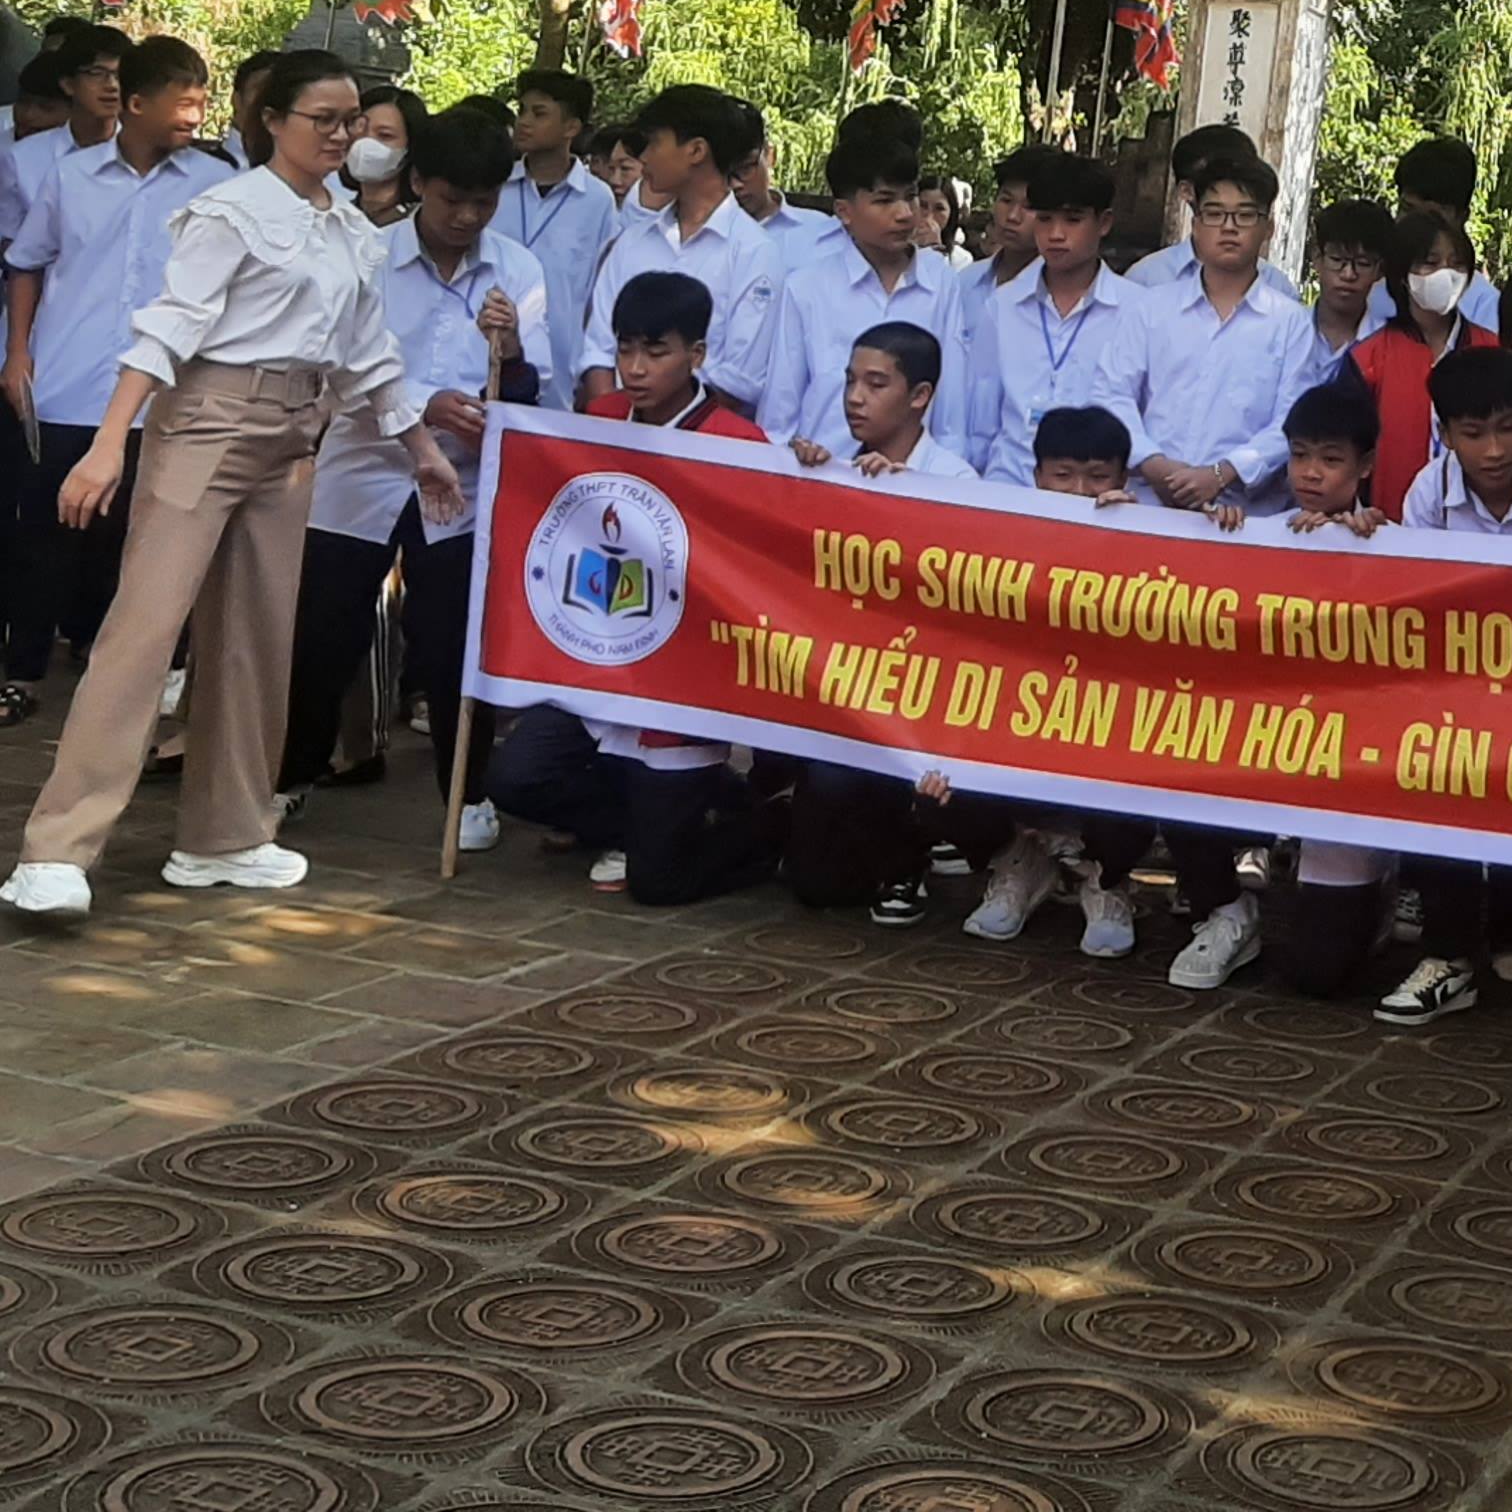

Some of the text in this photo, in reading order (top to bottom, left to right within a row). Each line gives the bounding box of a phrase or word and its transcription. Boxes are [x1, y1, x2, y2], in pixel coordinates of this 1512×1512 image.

[578, 481, 617, 498] THPT
[663, 540, 677, 571] LAN
[813, 529, 901, 609] HỌC
[917, 547, 1034, 622] SINH
[1048, 566, 1240, 651] TRƯỜNG
[1256, 593, 1426, 670] TRUNG
[710, 615, 813, 698] "TÌM
[819, 626, 940, 720] HIỂU
[945, 660, 1004, 731] DI
[1010, 655, 1121, 748] SẢN
[1128, 677, 1235, 764] VĂN
[1238, 694, 1345, 780] HÓA
[1359, 747, 1380, 762] -
[1396, 712, 1492, 798] GÌN
